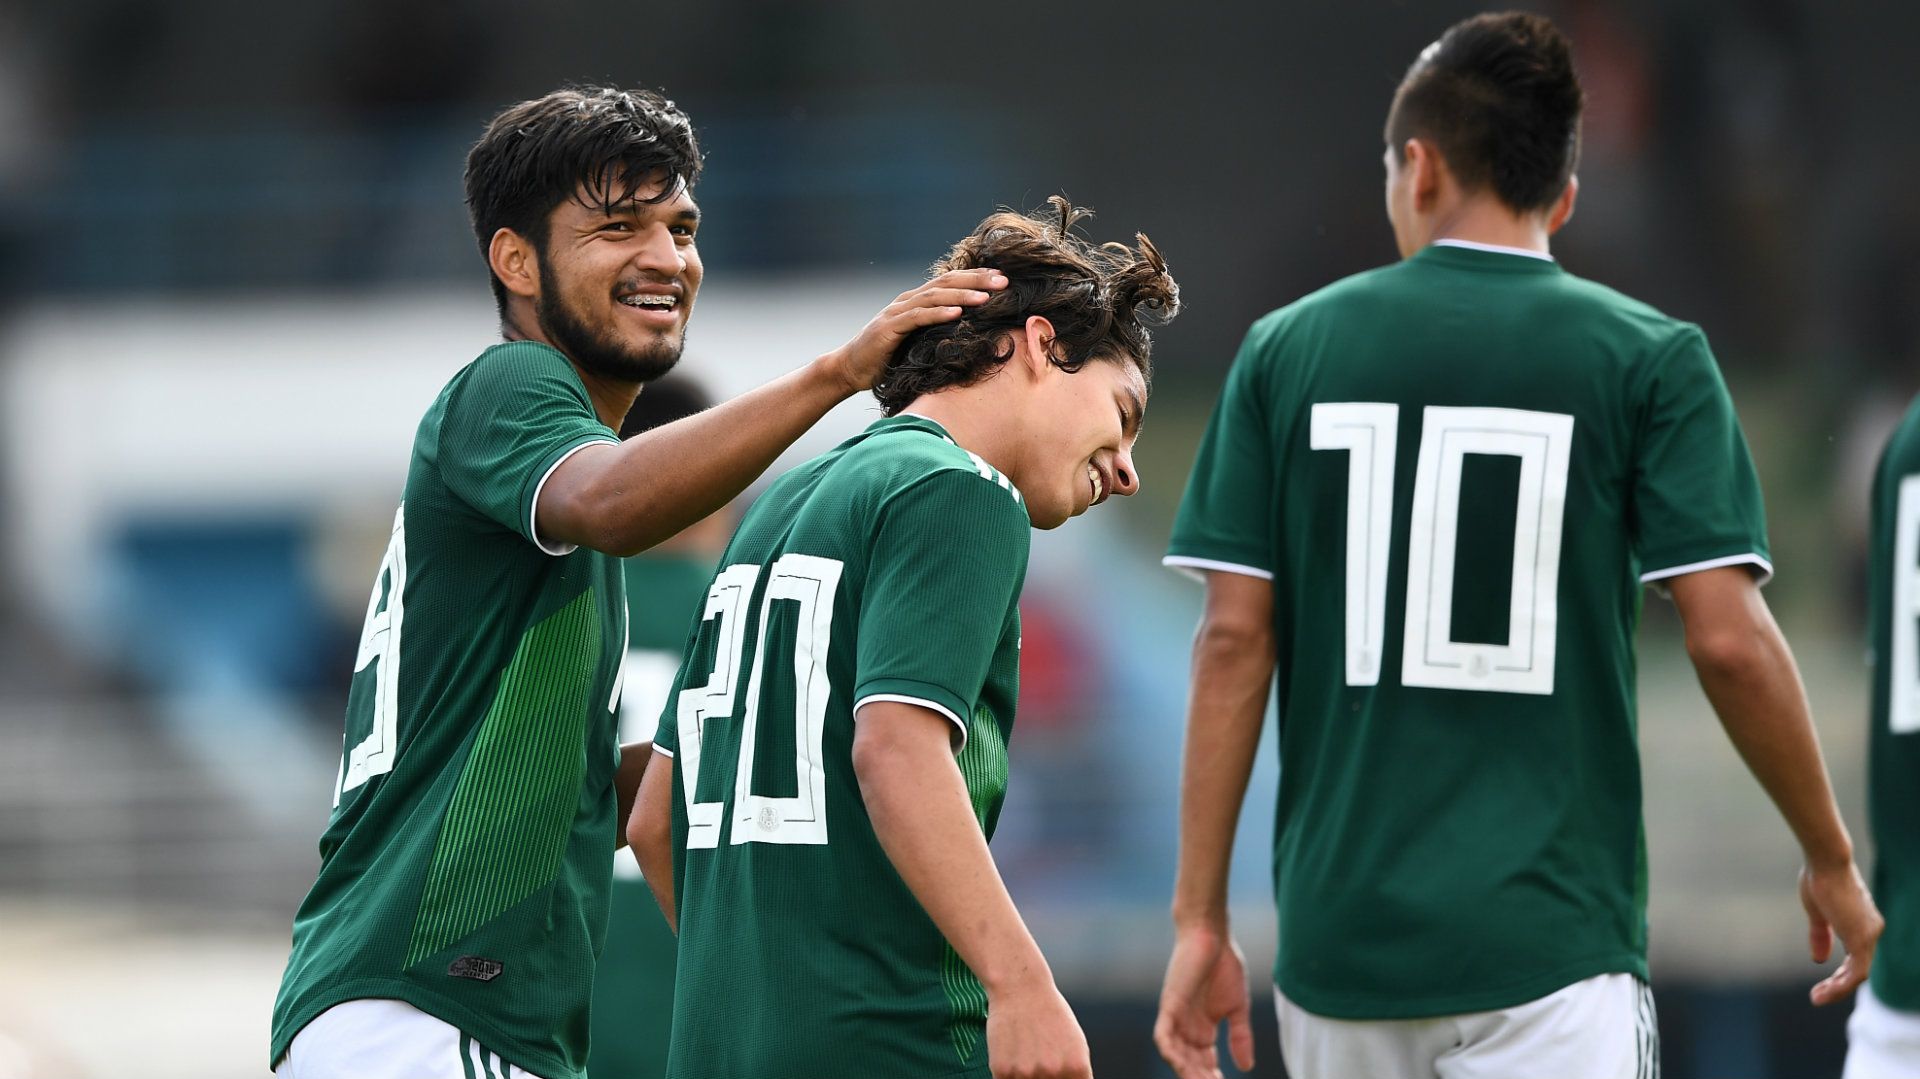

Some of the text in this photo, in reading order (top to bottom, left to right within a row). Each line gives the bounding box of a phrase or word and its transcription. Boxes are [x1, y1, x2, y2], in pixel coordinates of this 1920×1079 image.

[333, 500, 406, 808] 9
[1310, 402, 1574, 695] 10
[677, 553, 844, 849] 20
